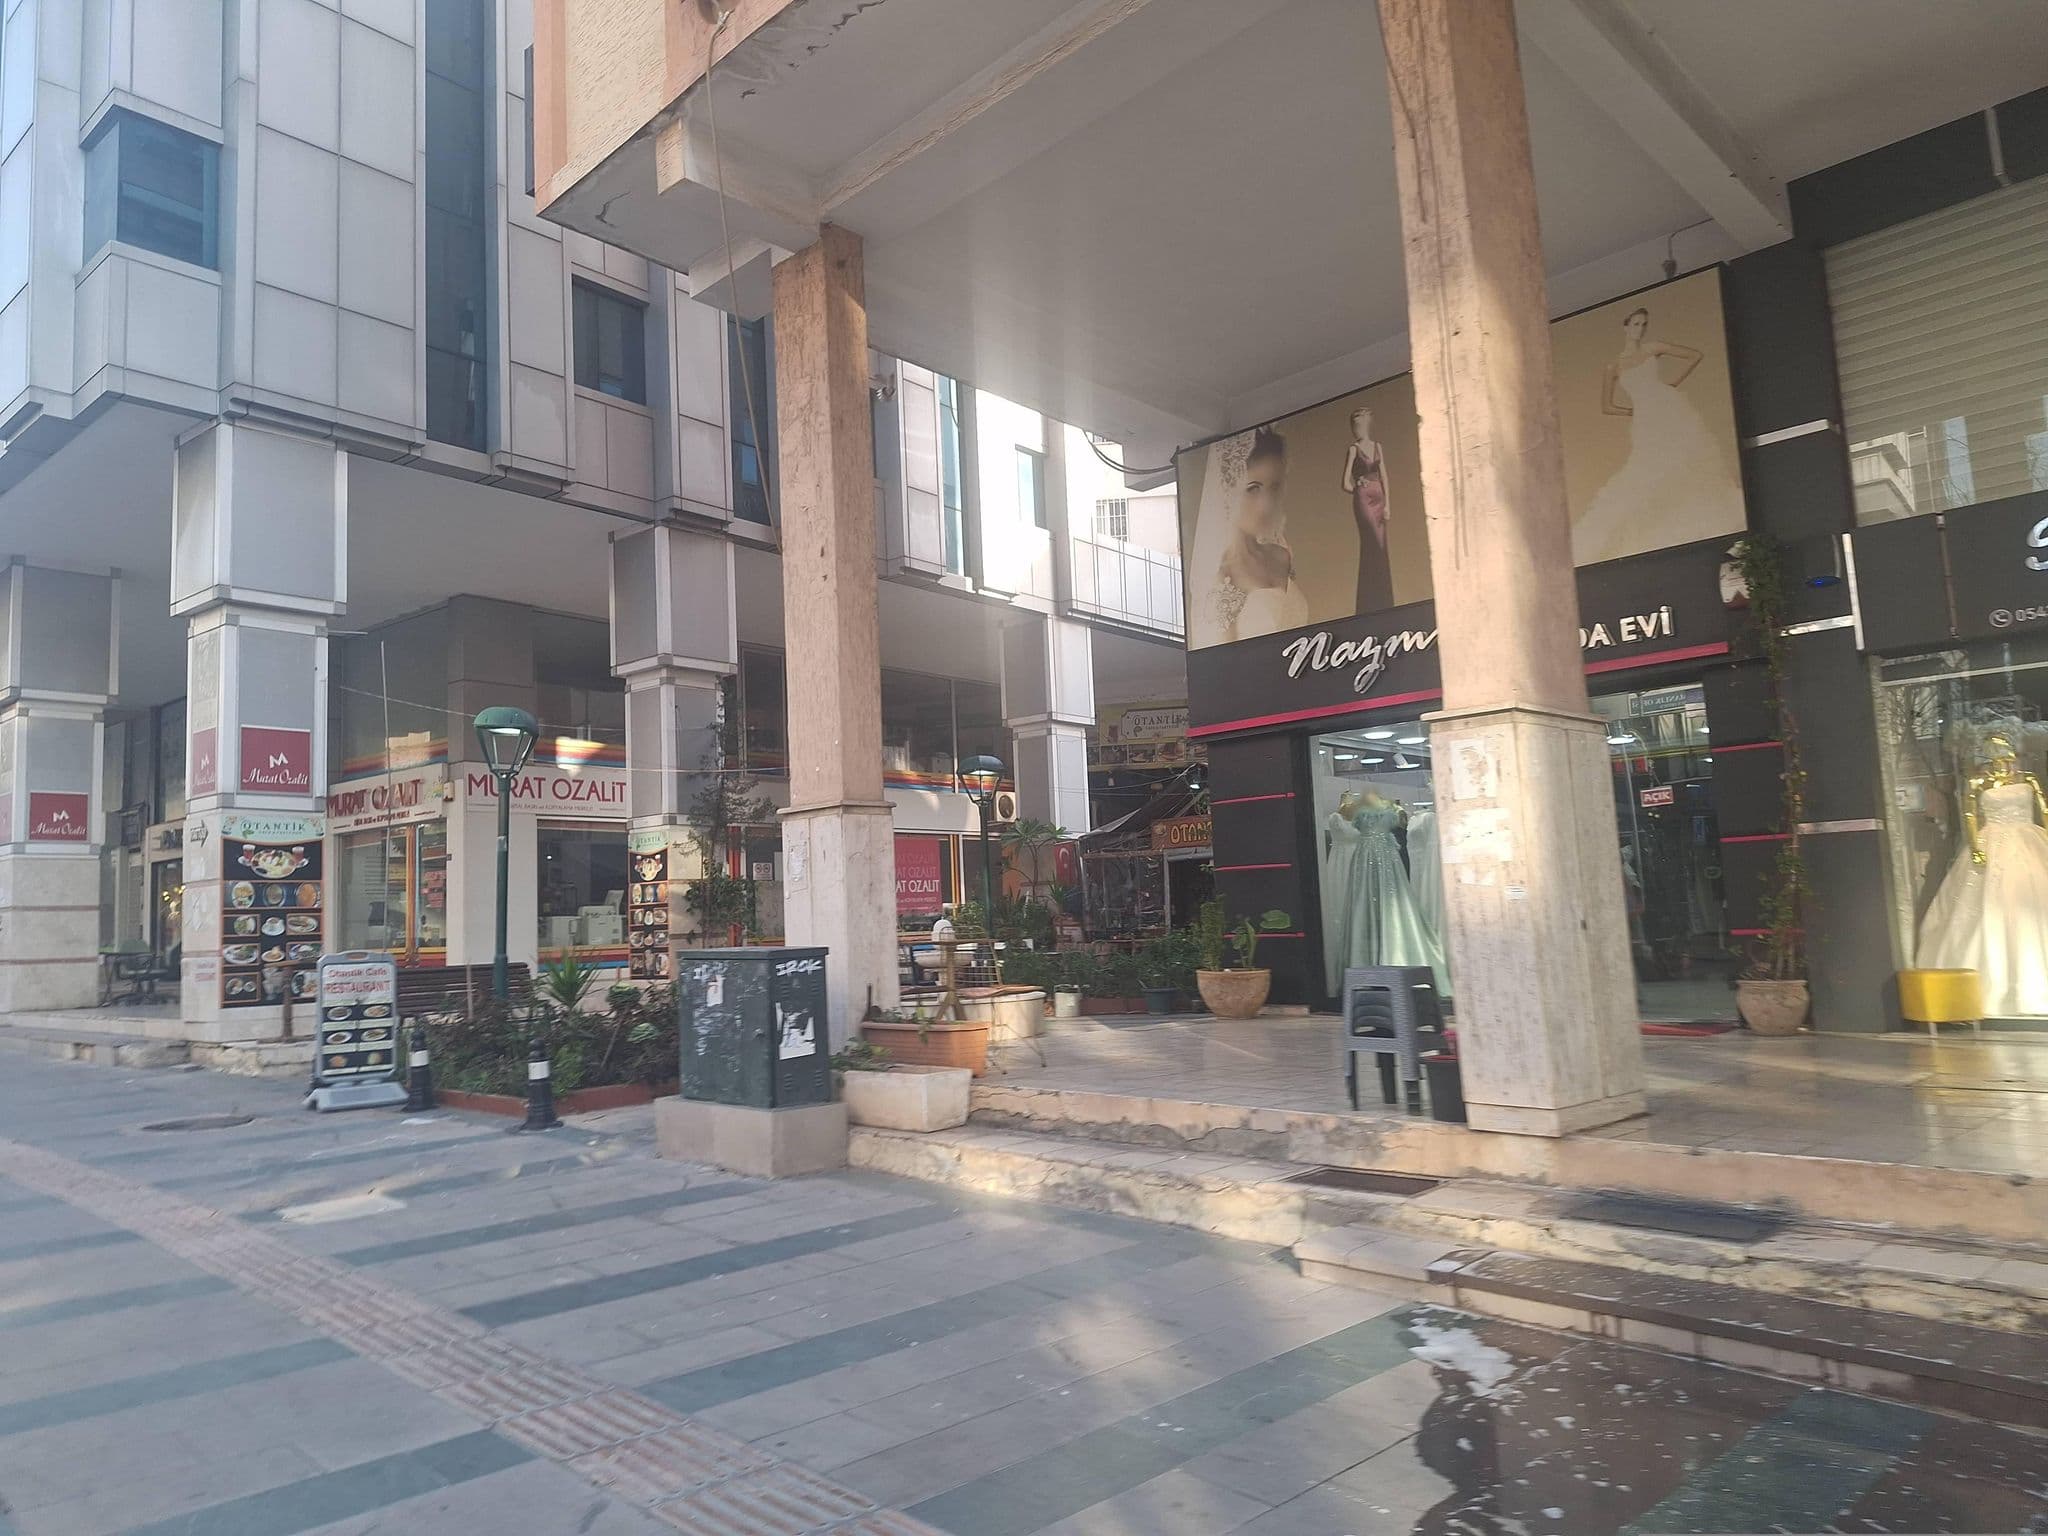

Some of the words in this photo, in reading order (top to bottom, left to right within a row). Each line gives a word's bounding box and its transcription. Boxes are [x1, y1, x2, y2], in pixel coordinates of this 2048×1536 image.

[2015, 605, 2048, 622] 054
[1282, 628, 1438, 693] Naym
[1620, 605, 1672, 642] EVİ
[242, 767, 278, 784] Murat
